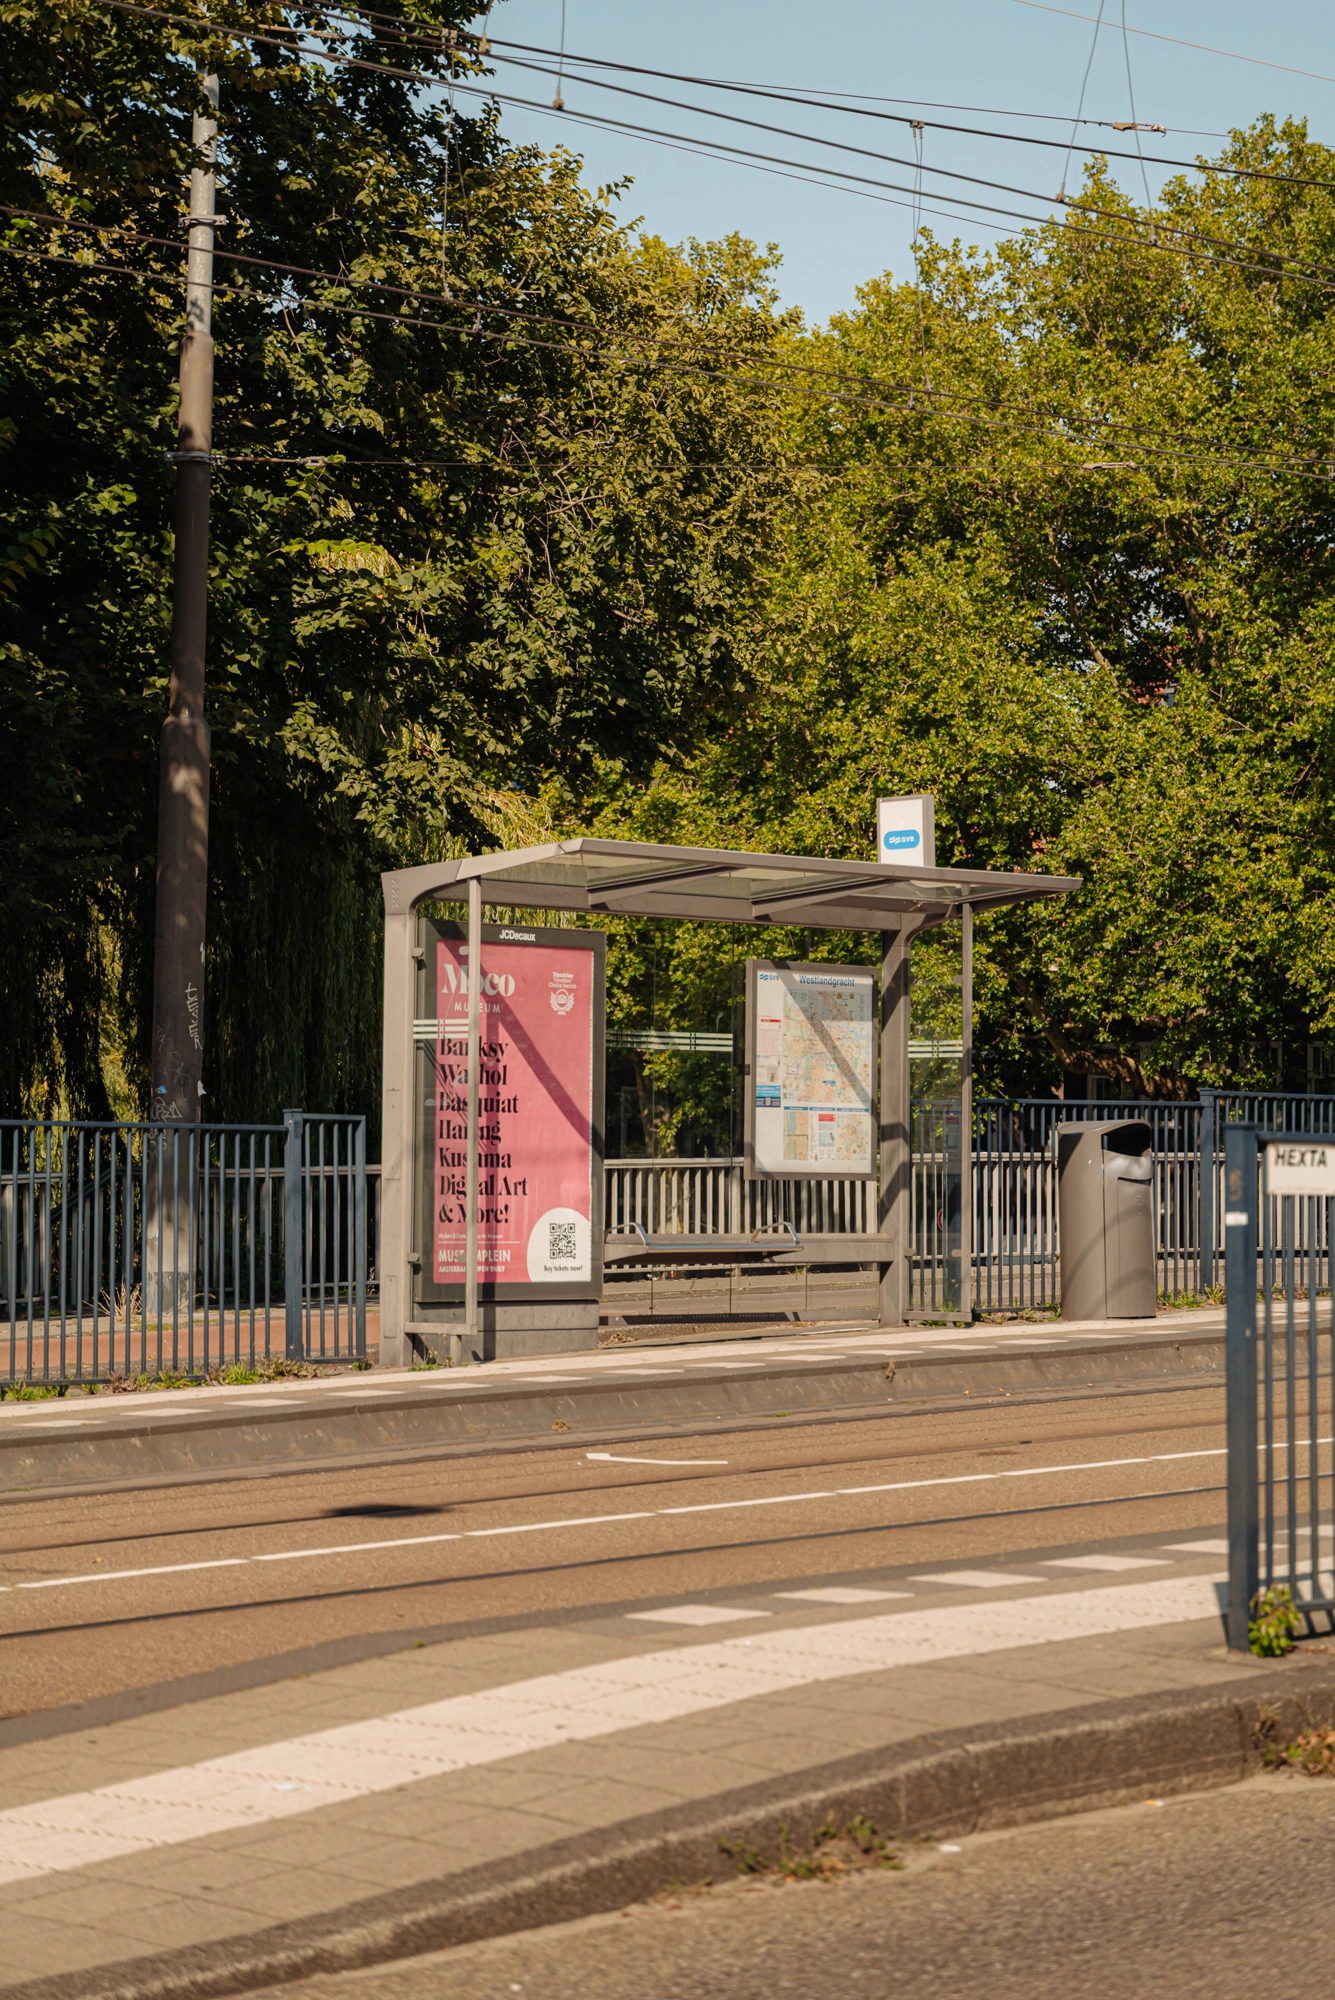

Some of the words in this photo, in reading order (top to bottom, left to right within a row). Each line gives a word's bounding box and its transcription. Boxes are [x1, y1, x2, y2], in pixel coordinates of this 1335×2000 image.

[499, 929, 536, 941] JCDecaux
[441, 963, 516, 996] Mco
[799, 974, 855, 988] Westlandgracht
[454, 1001, 501, 1013] MUEUM
[440, 1035, 509, 1063] Baksy
[439, 1063, 507, 1085] Wahol
[1274, 1148, 1327, 1167] HEXTA
[440, 1173, 495, 1201] Digal
[498, 1175, 528, 1196] Art
[439, 1203, 454, 1224] &
